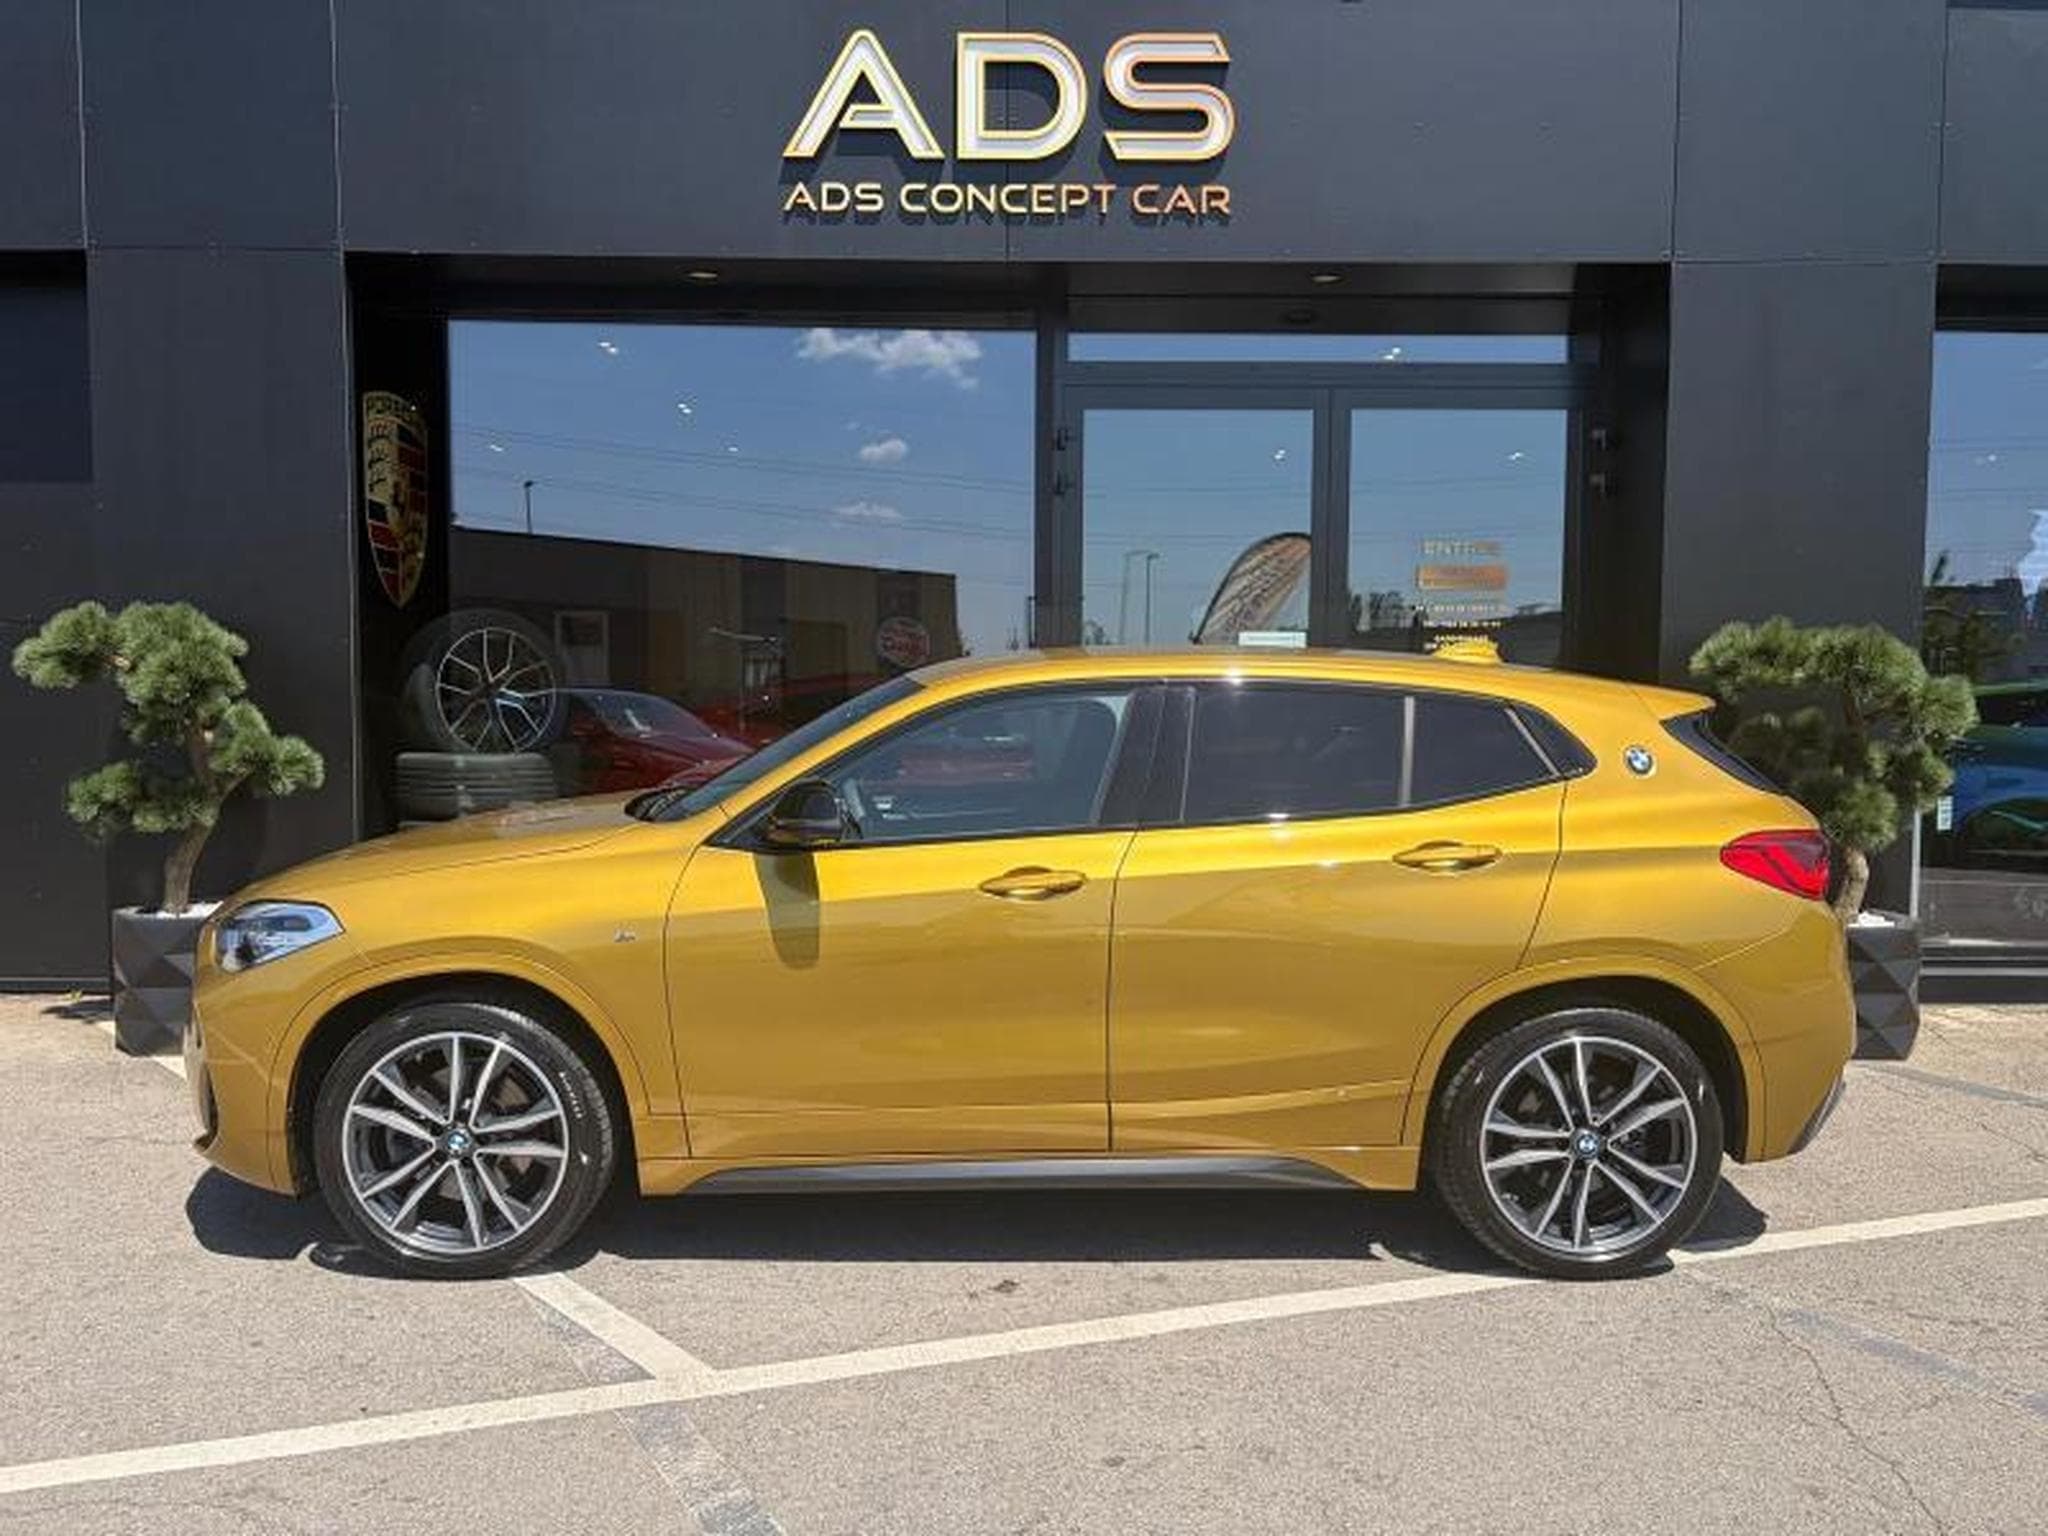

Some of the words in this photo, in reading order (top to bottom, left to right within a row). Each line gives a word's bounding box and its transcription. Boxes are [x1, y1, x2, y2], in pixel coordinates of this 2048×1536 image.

[782, 29, 1235, 161] ADS
[783, 181, 884, 213] ADS
[900, 182, 1117, 214] CONCEPT
[1132, 183, 1231, 215] CAR
